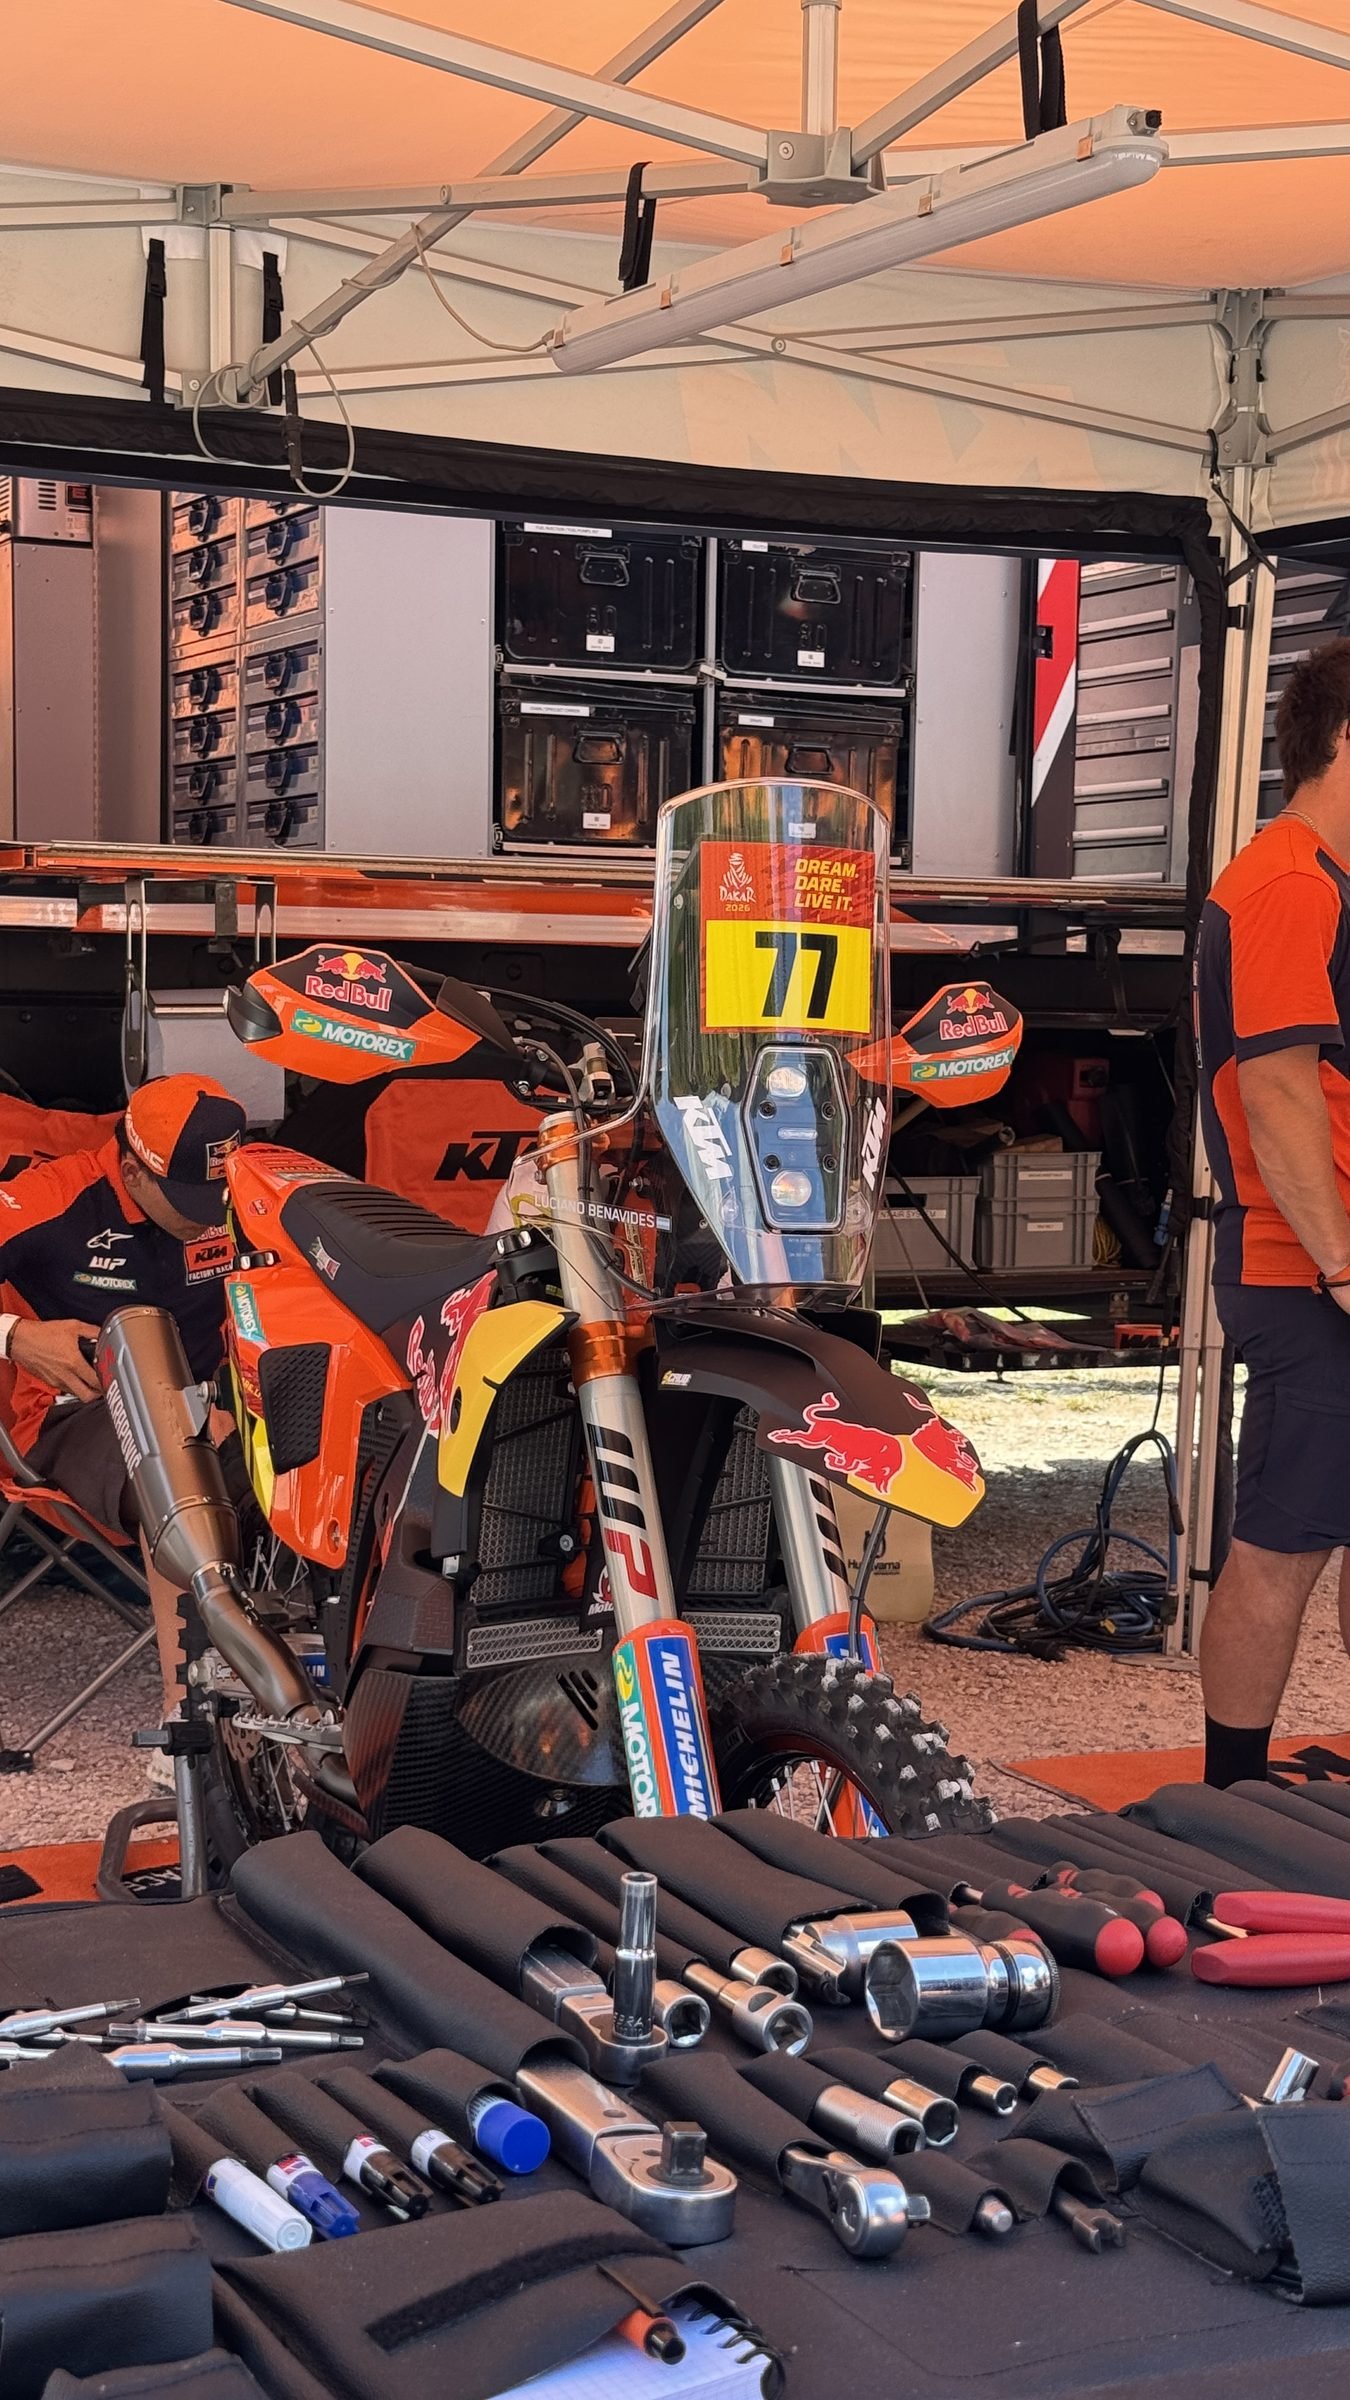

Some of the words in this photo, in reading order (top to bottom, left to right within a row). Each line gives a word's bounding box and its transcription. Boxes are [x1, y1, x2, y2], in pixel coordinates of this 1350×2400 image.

[794, 858, 859, 879] DREAM.
[719, 885, 757, 904] DAKAR
[794, 876, 846, 894] DARE.
[725, 904, 751, 912] 2026
[794, 892, 834, 910] LIVE
[836, 896, 853, 912] IT.
[755, 931, 838, 1019] 77
[305, 975, 351, 1003] Red
[351, 982, 393, 1012] Bull
[322, 1022, 410, 1059] MOTOREX
[940, 1015, 976, 1041] Red
[975, 1011, 1009, 1036] Bull
[938, 1049, 1013, 1078] MOTOREX
[673, 1095, 733, 1180] KTM
[434, 1130, 540, 1181] KT
[534, 1192, 586, 1215] LUCIANO
[588, 1203, 655, 1227] BENAVIDES
[89, 1256, 126, 1271] WP
[194, 1245, 228, 1264] KTM
[91, 1275, 136, 1290] MOTOREX
[189, 1268, 215, 1281] FACTORY
[661, 1651, 709, 1822] MICHELIN
[621, 1702, 658, 1819] MOTOR
